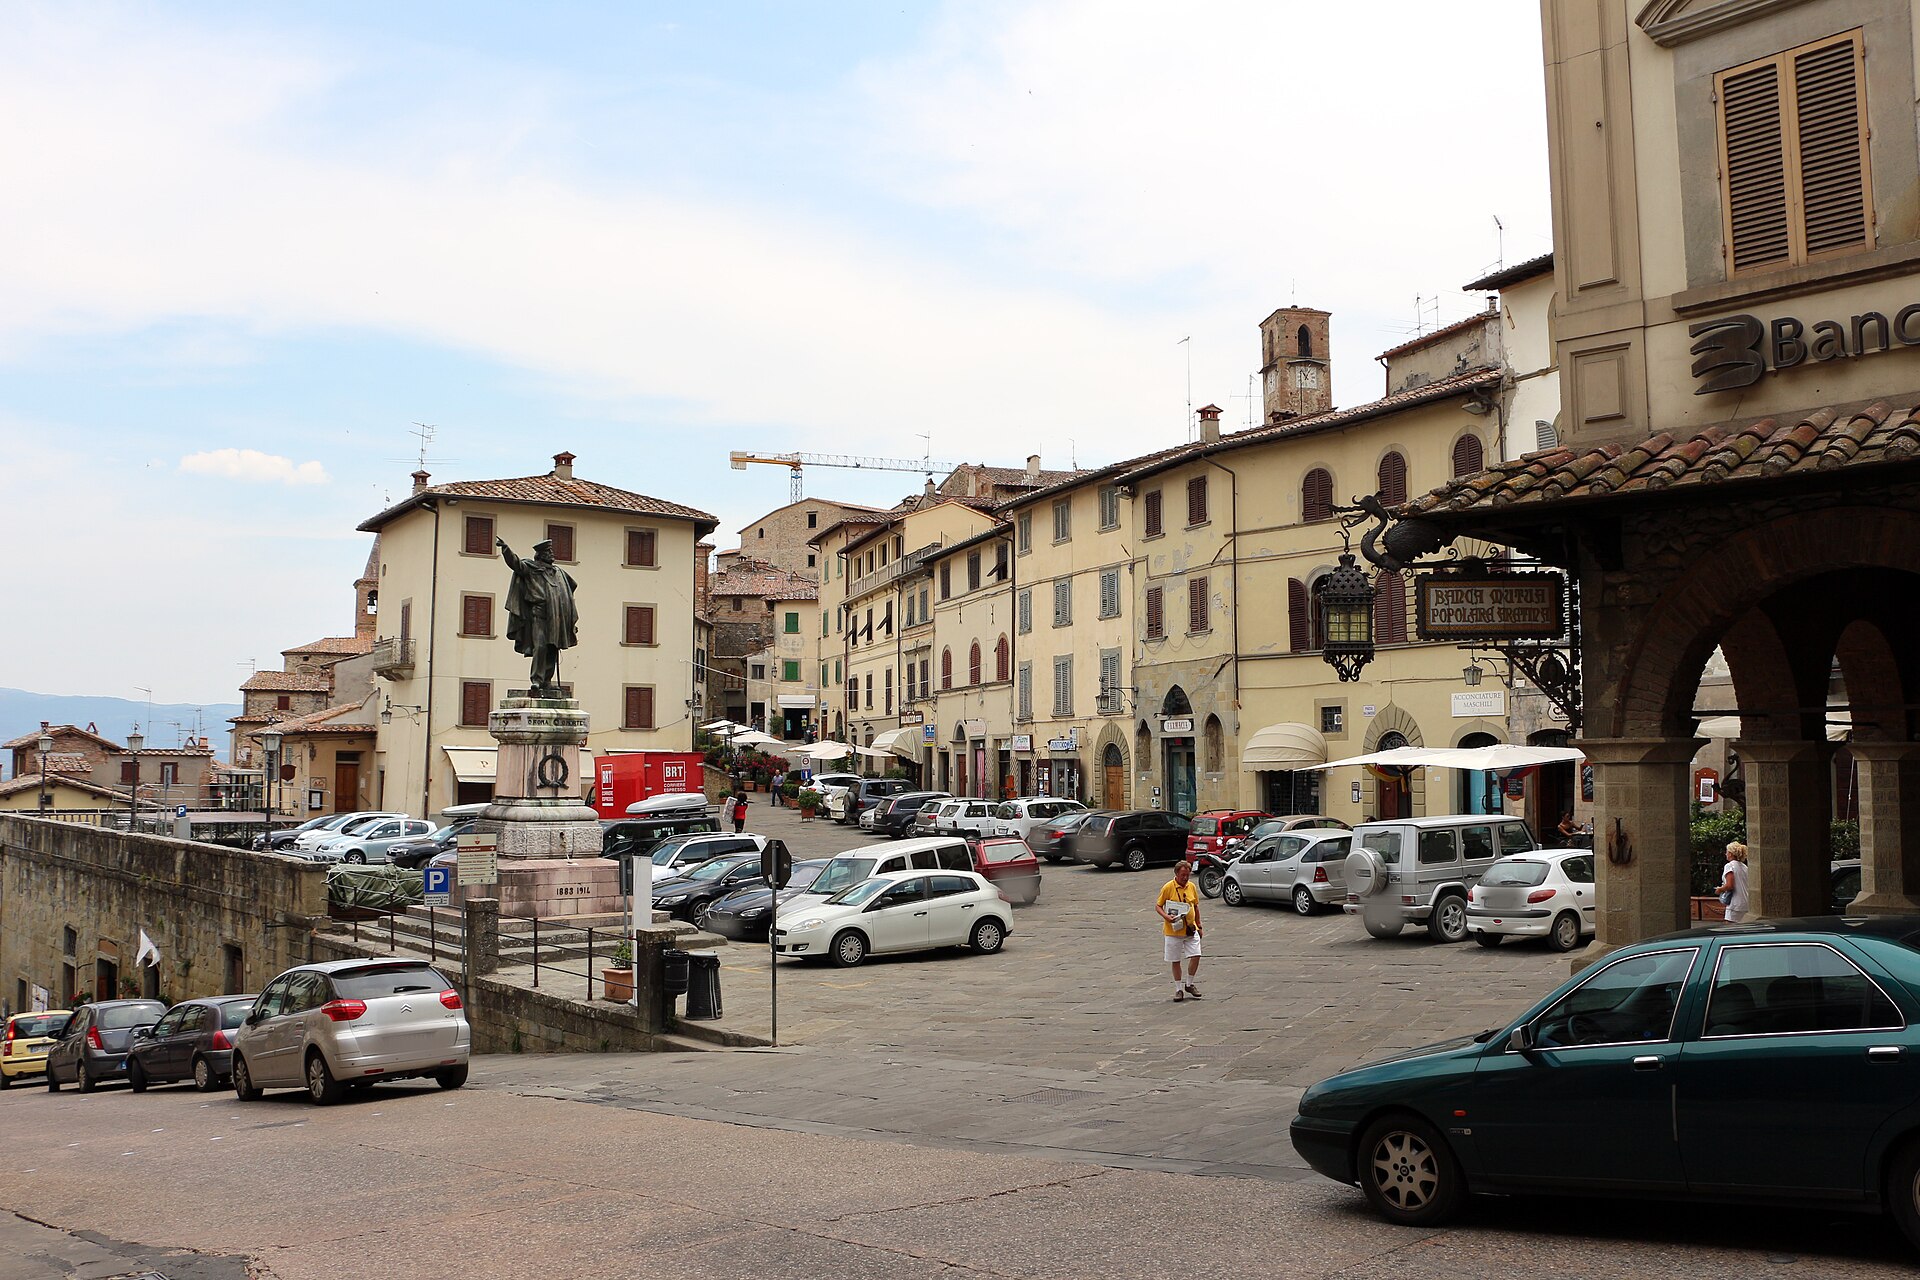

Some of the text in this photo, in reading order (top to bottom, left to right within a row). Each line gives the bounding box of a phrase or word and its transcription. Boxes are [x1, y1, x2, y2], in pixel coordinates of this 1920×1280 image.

[1435, 588, 1546, 606] BANCA MUTUA
[1431, 606, 1495, 623] POPOLARE
[1453, 692, 1501, 701] ACCONCIATURE
[665, 766, 683, 777] BRT
[178, 806, 185, 815] P
[429, 871, 445, 891] P
[556, 887, 574, 895] 1883
